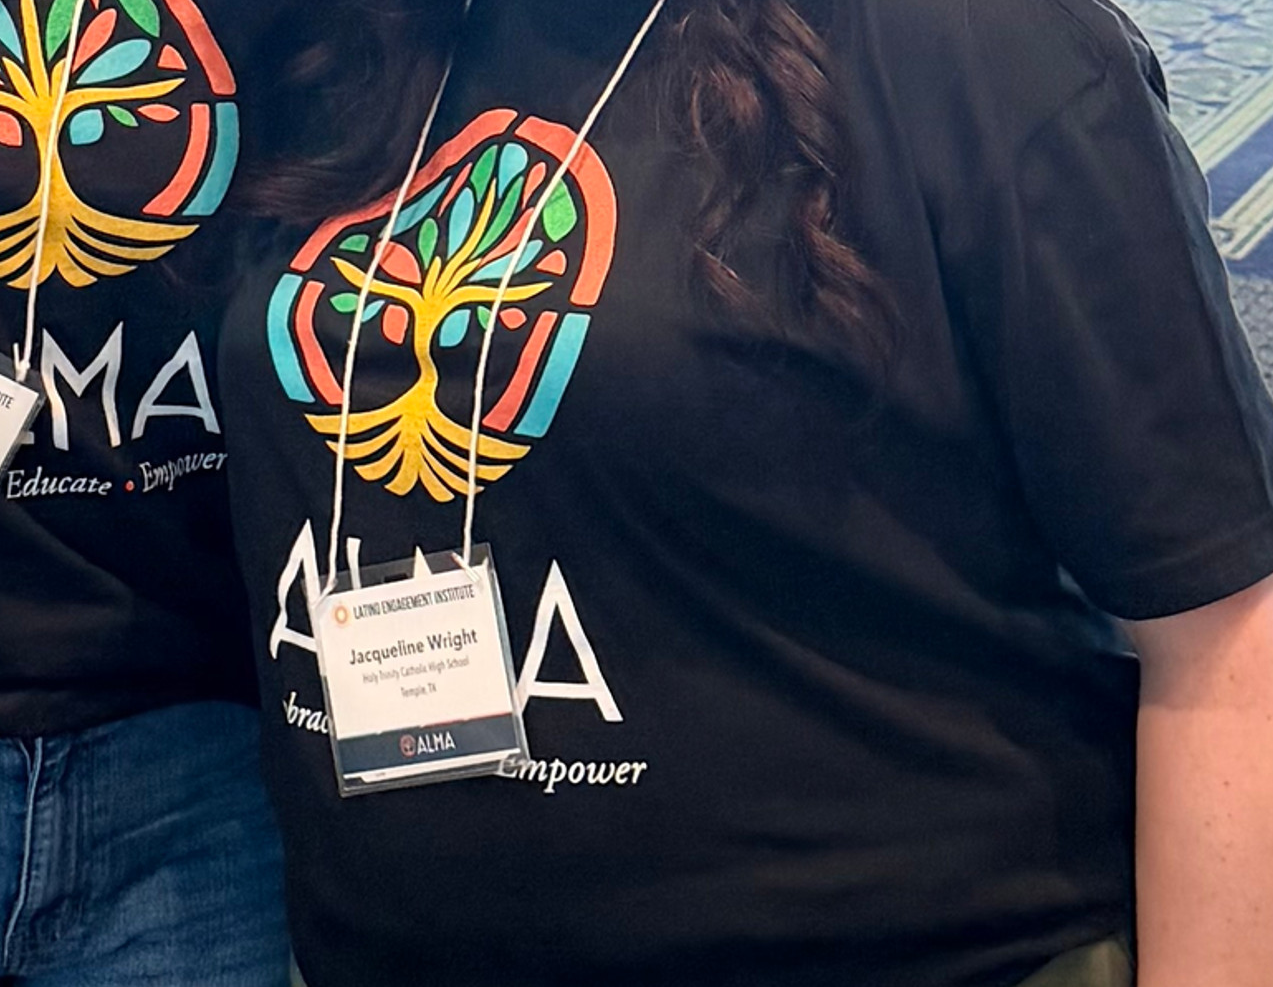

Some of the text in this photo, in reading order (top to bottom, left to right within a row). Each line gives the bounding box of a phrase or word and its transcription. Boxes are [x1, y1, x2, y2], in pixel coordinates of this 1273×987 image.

[7, 452, 228, 499] Educate Empower
[269, 518, 624, 723] AA
[353, 584, 475, 620] LATINO ENGAGEMENT INSTITUTE
[349, 628, 478, 665] Jacqueline Wright
[428, 660, 446, 674] High
[447, 655, 470, 669] School
[417, 731, 456, 754] ALMA
[495, 756, 648, 793] Empower
